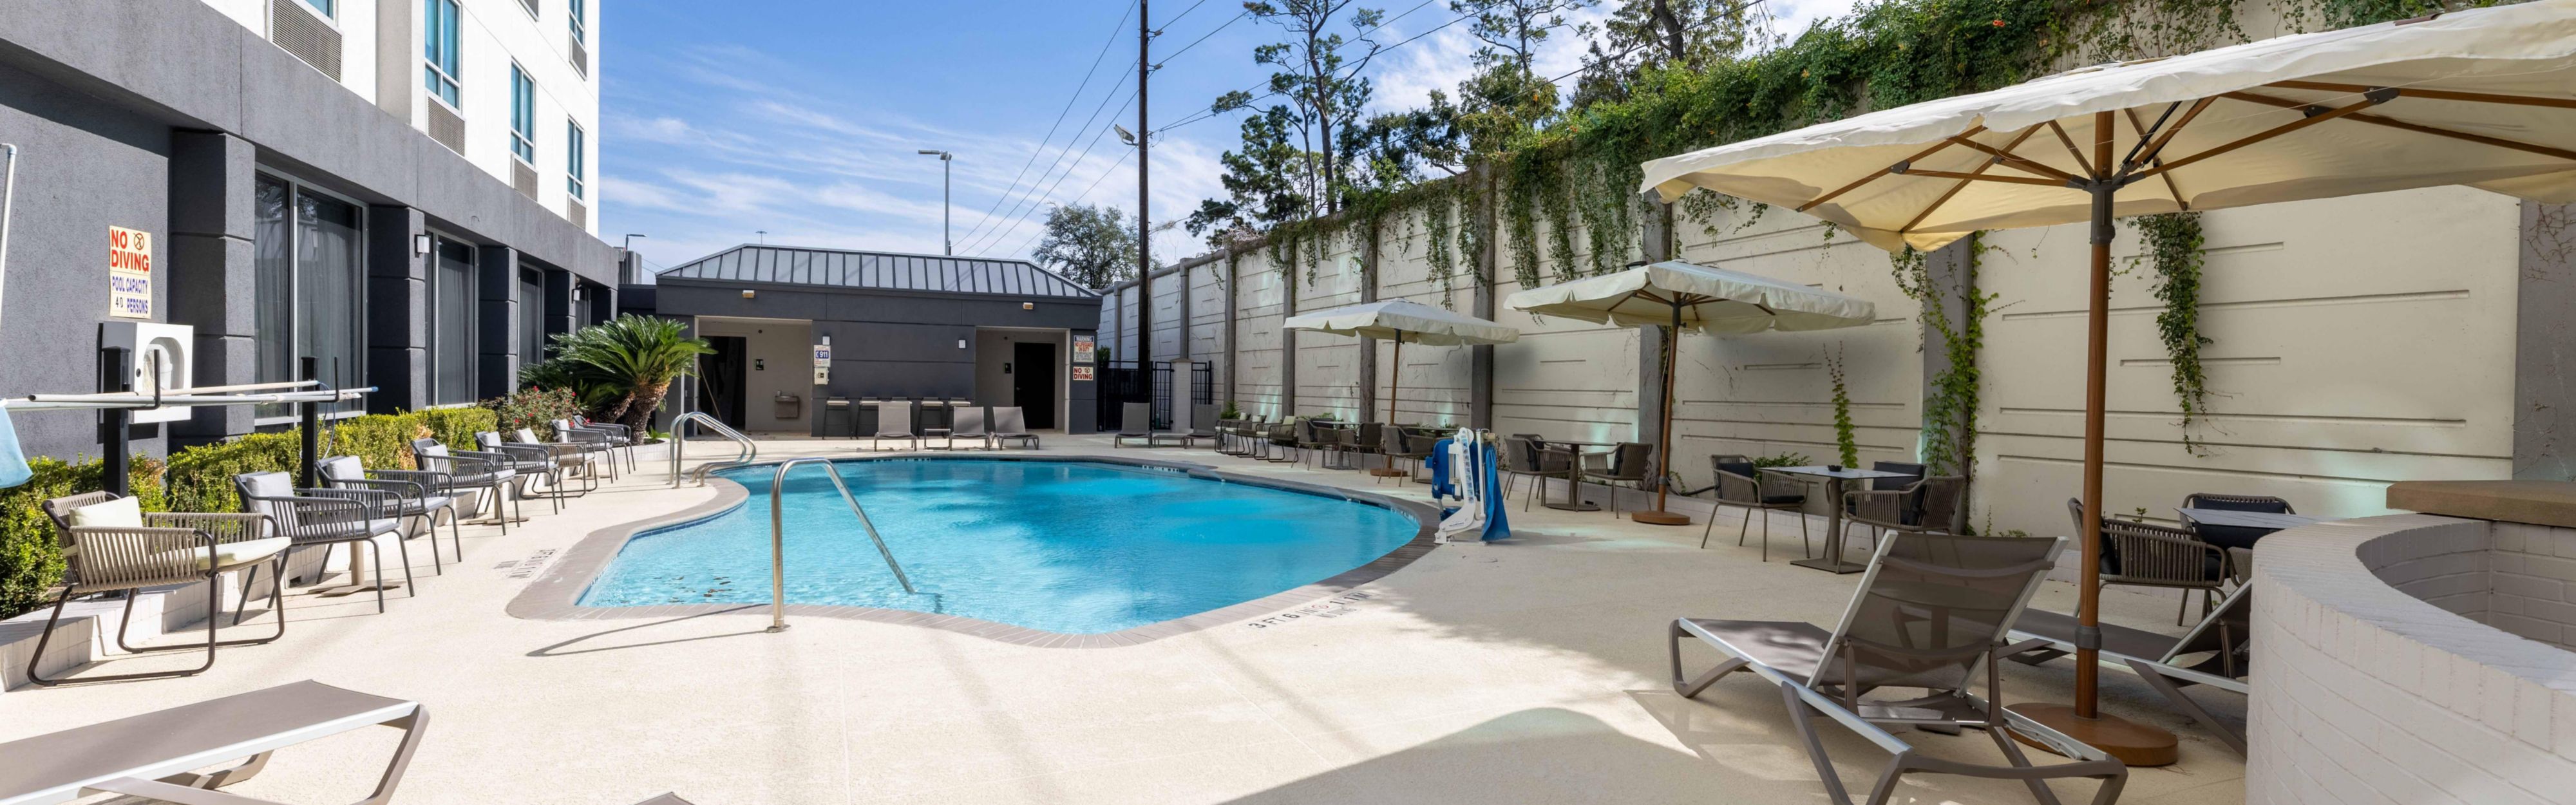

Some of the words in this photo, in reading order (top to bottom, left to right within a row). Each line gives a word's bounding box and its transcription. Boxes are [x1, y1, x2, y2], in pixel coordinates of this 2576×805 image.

[111, 229, 128, 249] NO
[111, 249, 149, 272] DIVING
[112, 276, 125, 292] POOL
[126, 278, 148, 294] CAPACITY
[127, 298, 148, 314] PERSONS
[1262, 617, 1287, 625] FT
